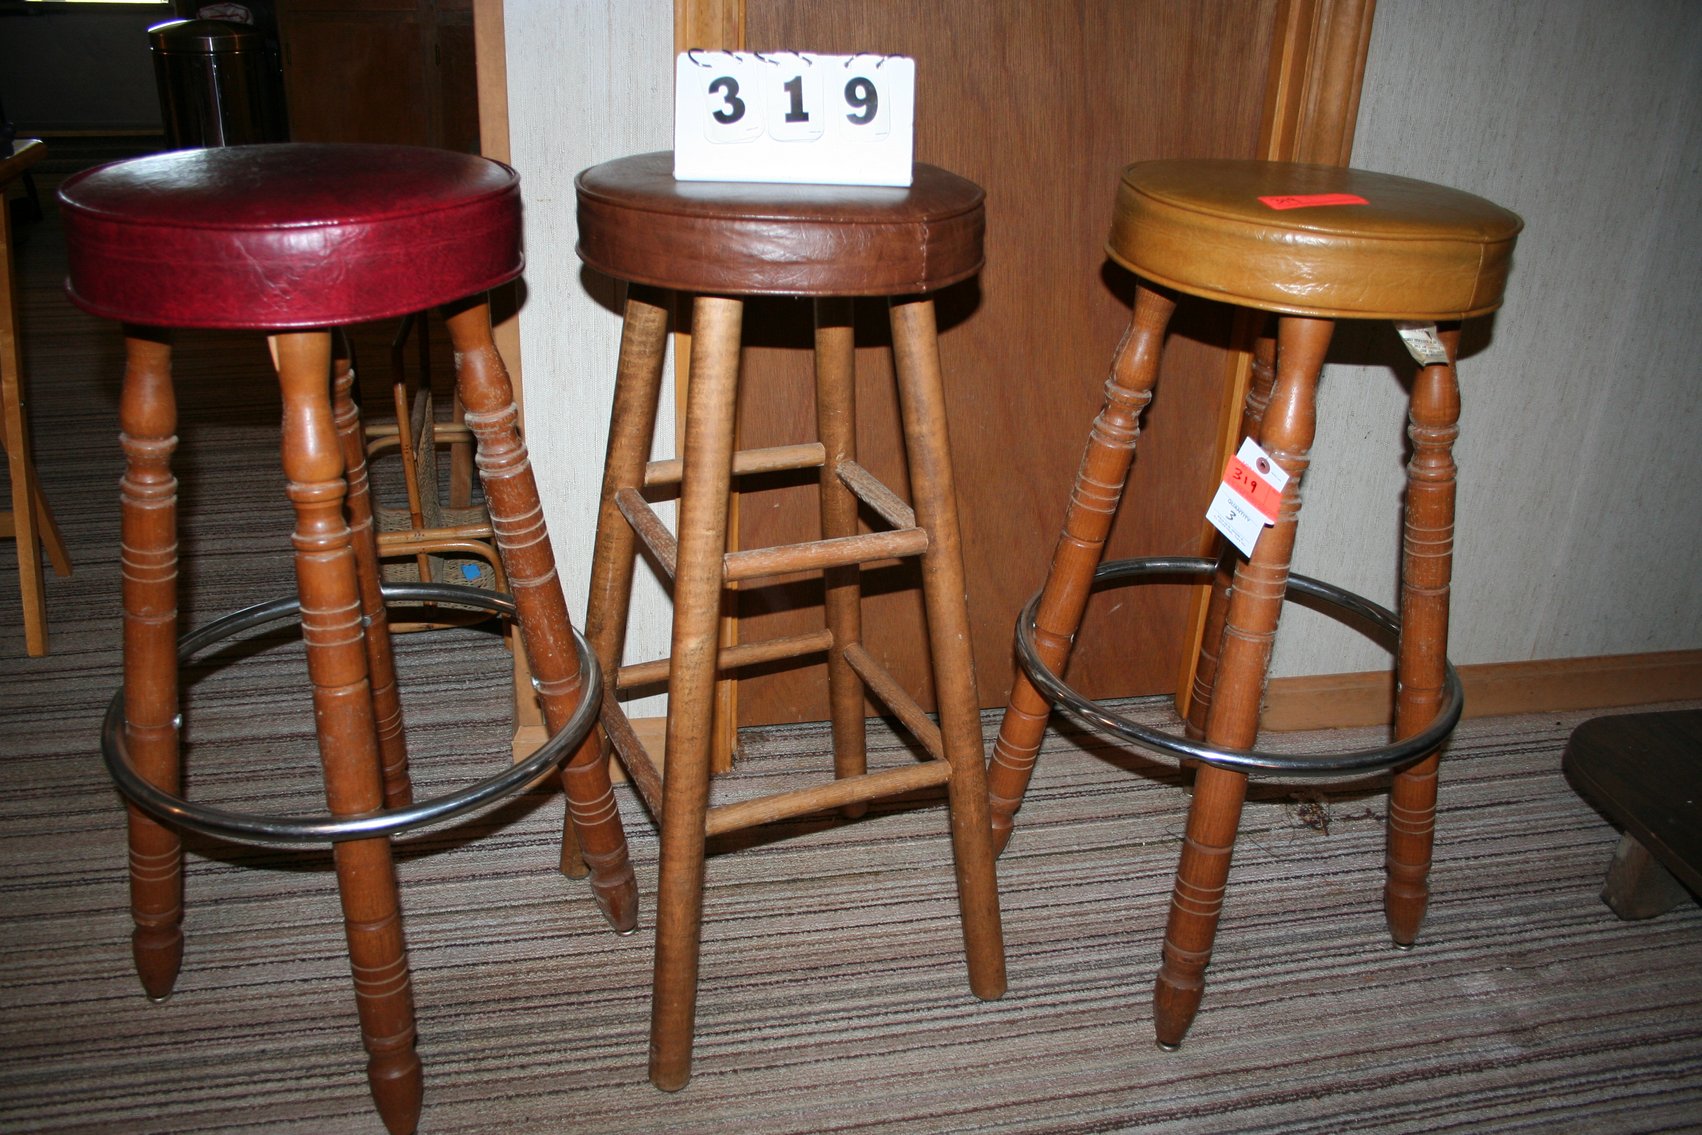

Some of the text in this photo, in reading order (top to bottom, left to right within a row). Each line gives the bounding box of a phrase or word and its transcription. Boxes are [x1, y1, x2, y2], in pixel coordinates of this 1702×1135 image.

[1233, 467, 1257, 493] 319
[1225, 510, 1236, 521] 3
[1227, 498, 1250, 522] QUANTITY
